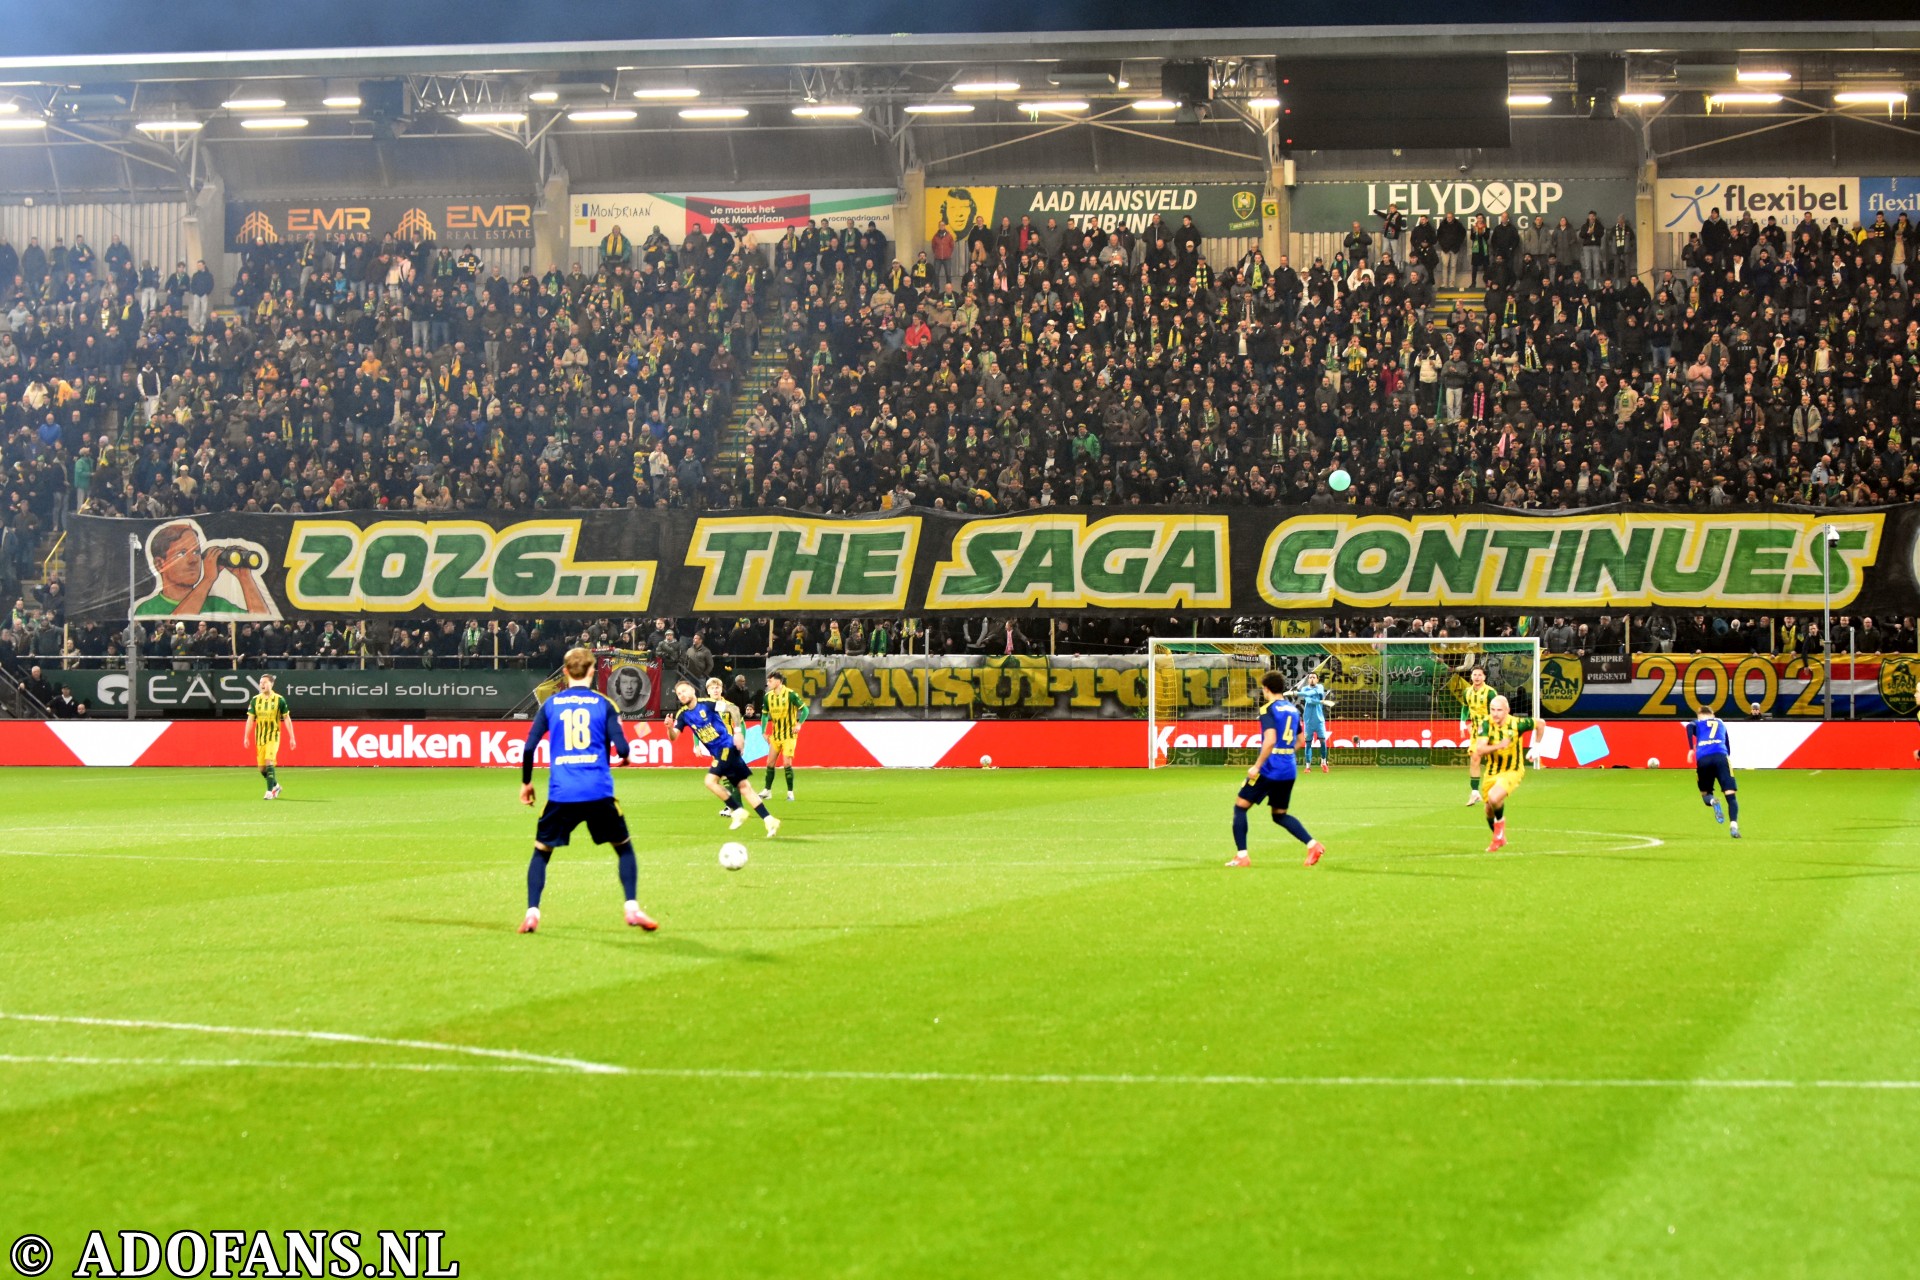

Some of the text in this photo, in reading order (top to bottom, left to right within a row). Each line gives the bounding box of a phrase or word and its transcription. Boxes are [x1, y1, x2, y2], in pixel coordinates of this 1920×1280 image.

[1029, 189, 1198, 212] AAD MANSVELD
[1724, 184, 1848, 211] flexibel
[287, 207, 371, 231] EMR
[446, 204, 531, 228] EMR
[710, 205, 776, 214] Je maakt het
[732, 214, 785, 224] Mondriaan
[1264, 204, 1276, 216] G
[446, 229, 531, 240] REAL ESTATE
[704, 530, 907, 596] THE
[940, 530, 1218, 594] SAGA
[1267, 527, 1868, 594] CONTINUES
[1590, 655, 1623, 663] SEMPRE
[1541, 678, 1579, 689] FAN
[1587, 673, 1627, 681] PRESENTI
[1637, 656, 1826, 715] 2002
[286, 682, 388, 696] technical
[395, 682, 498, 696] solutions
[559, 708, 591, 750] 18
[1282, 715, 1293, 746] 4
[1706, 720, 1718, 739] 7
[332, 725, 471, 758] Keuken
[1328, 754, 1376, 764] Slimmer.
[1380, 754, 1429, 764] Schoner.
